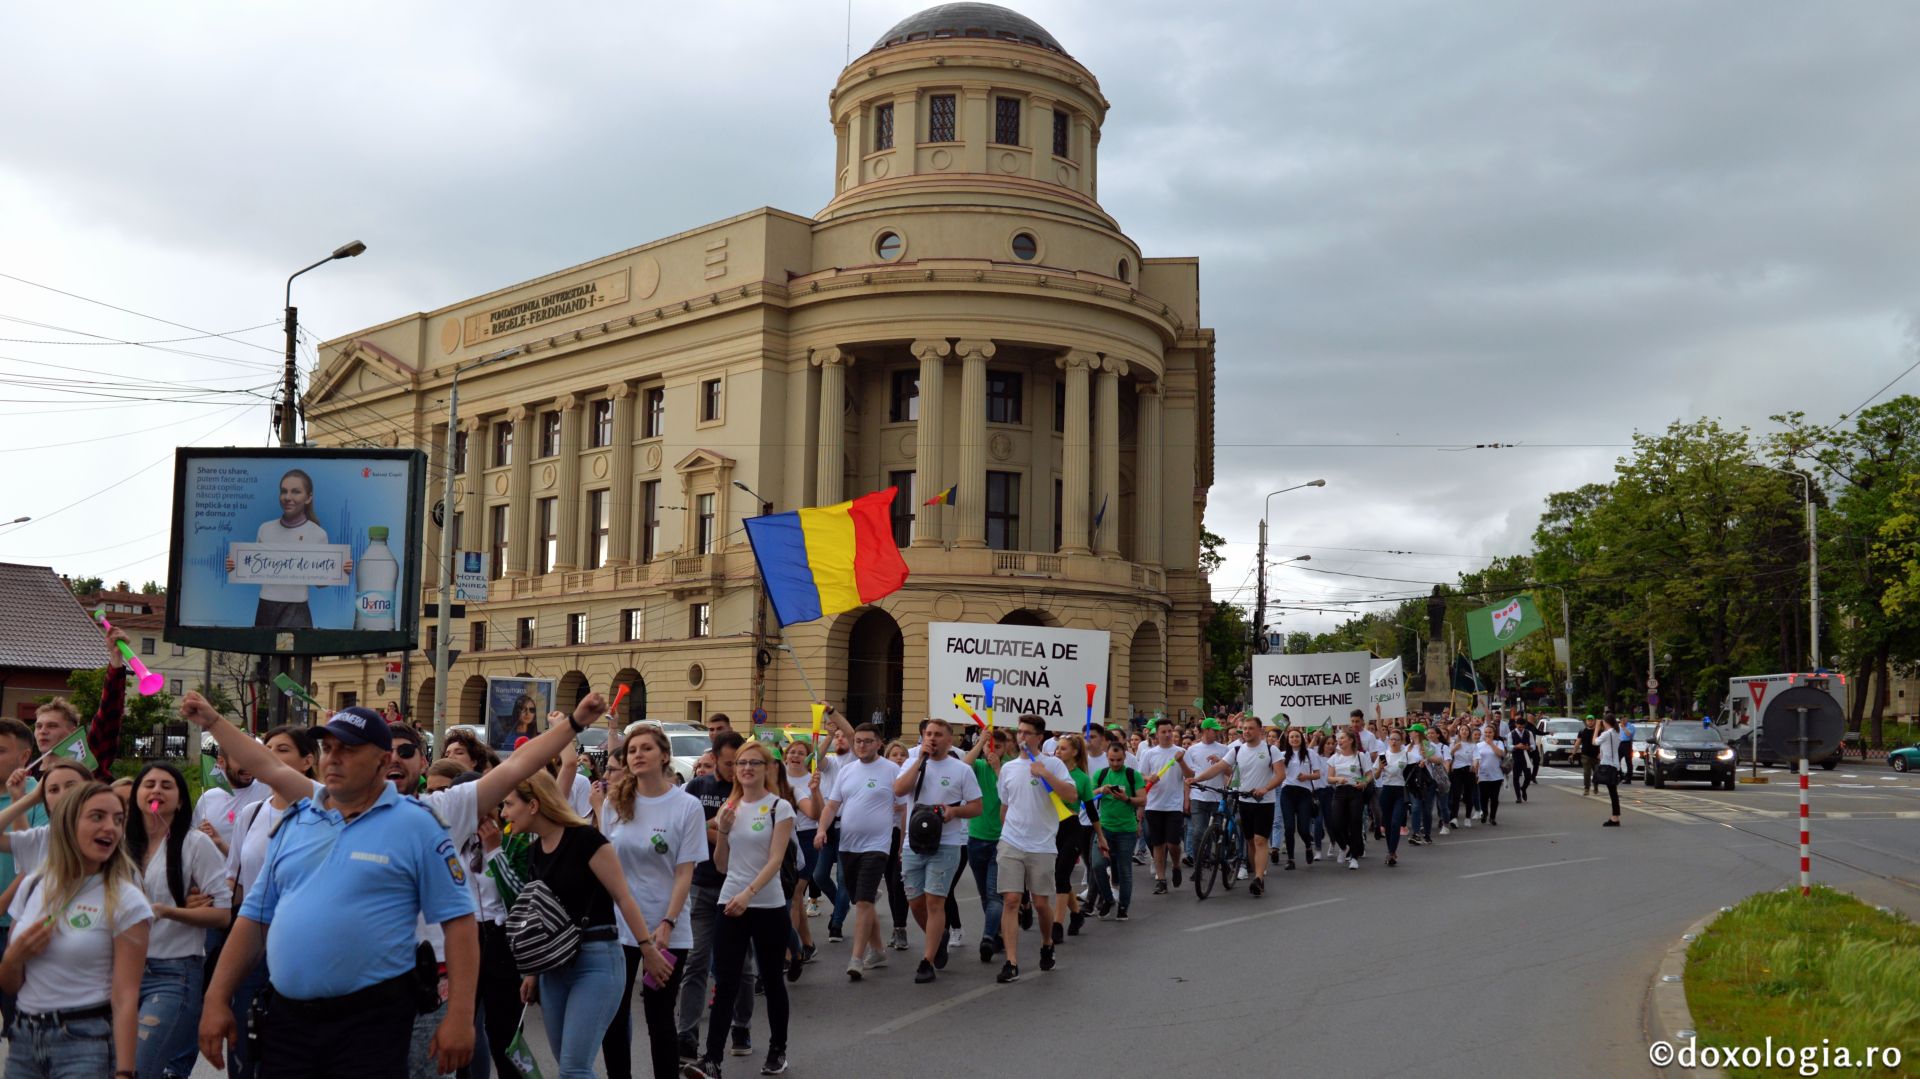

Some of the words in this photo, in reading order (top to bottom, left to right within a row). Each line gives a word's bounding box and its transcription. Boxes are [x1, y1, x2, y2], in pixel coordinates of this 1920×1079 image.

[297, 558, 309, 570] de
[947, 637, 1046, 658] FACULTATEA
[1052, 643, 1078, 660] DE
[966, 666, 1050, 688] MEDICINĂ
[1268, 672, 1342, 686] FACULTATEA
[1345, 671, 1360, 683] DE
[953, 693, 1063, 717] ETRINARĂ
[1280, 693, 1353, 707] ZOOTEHNIE
